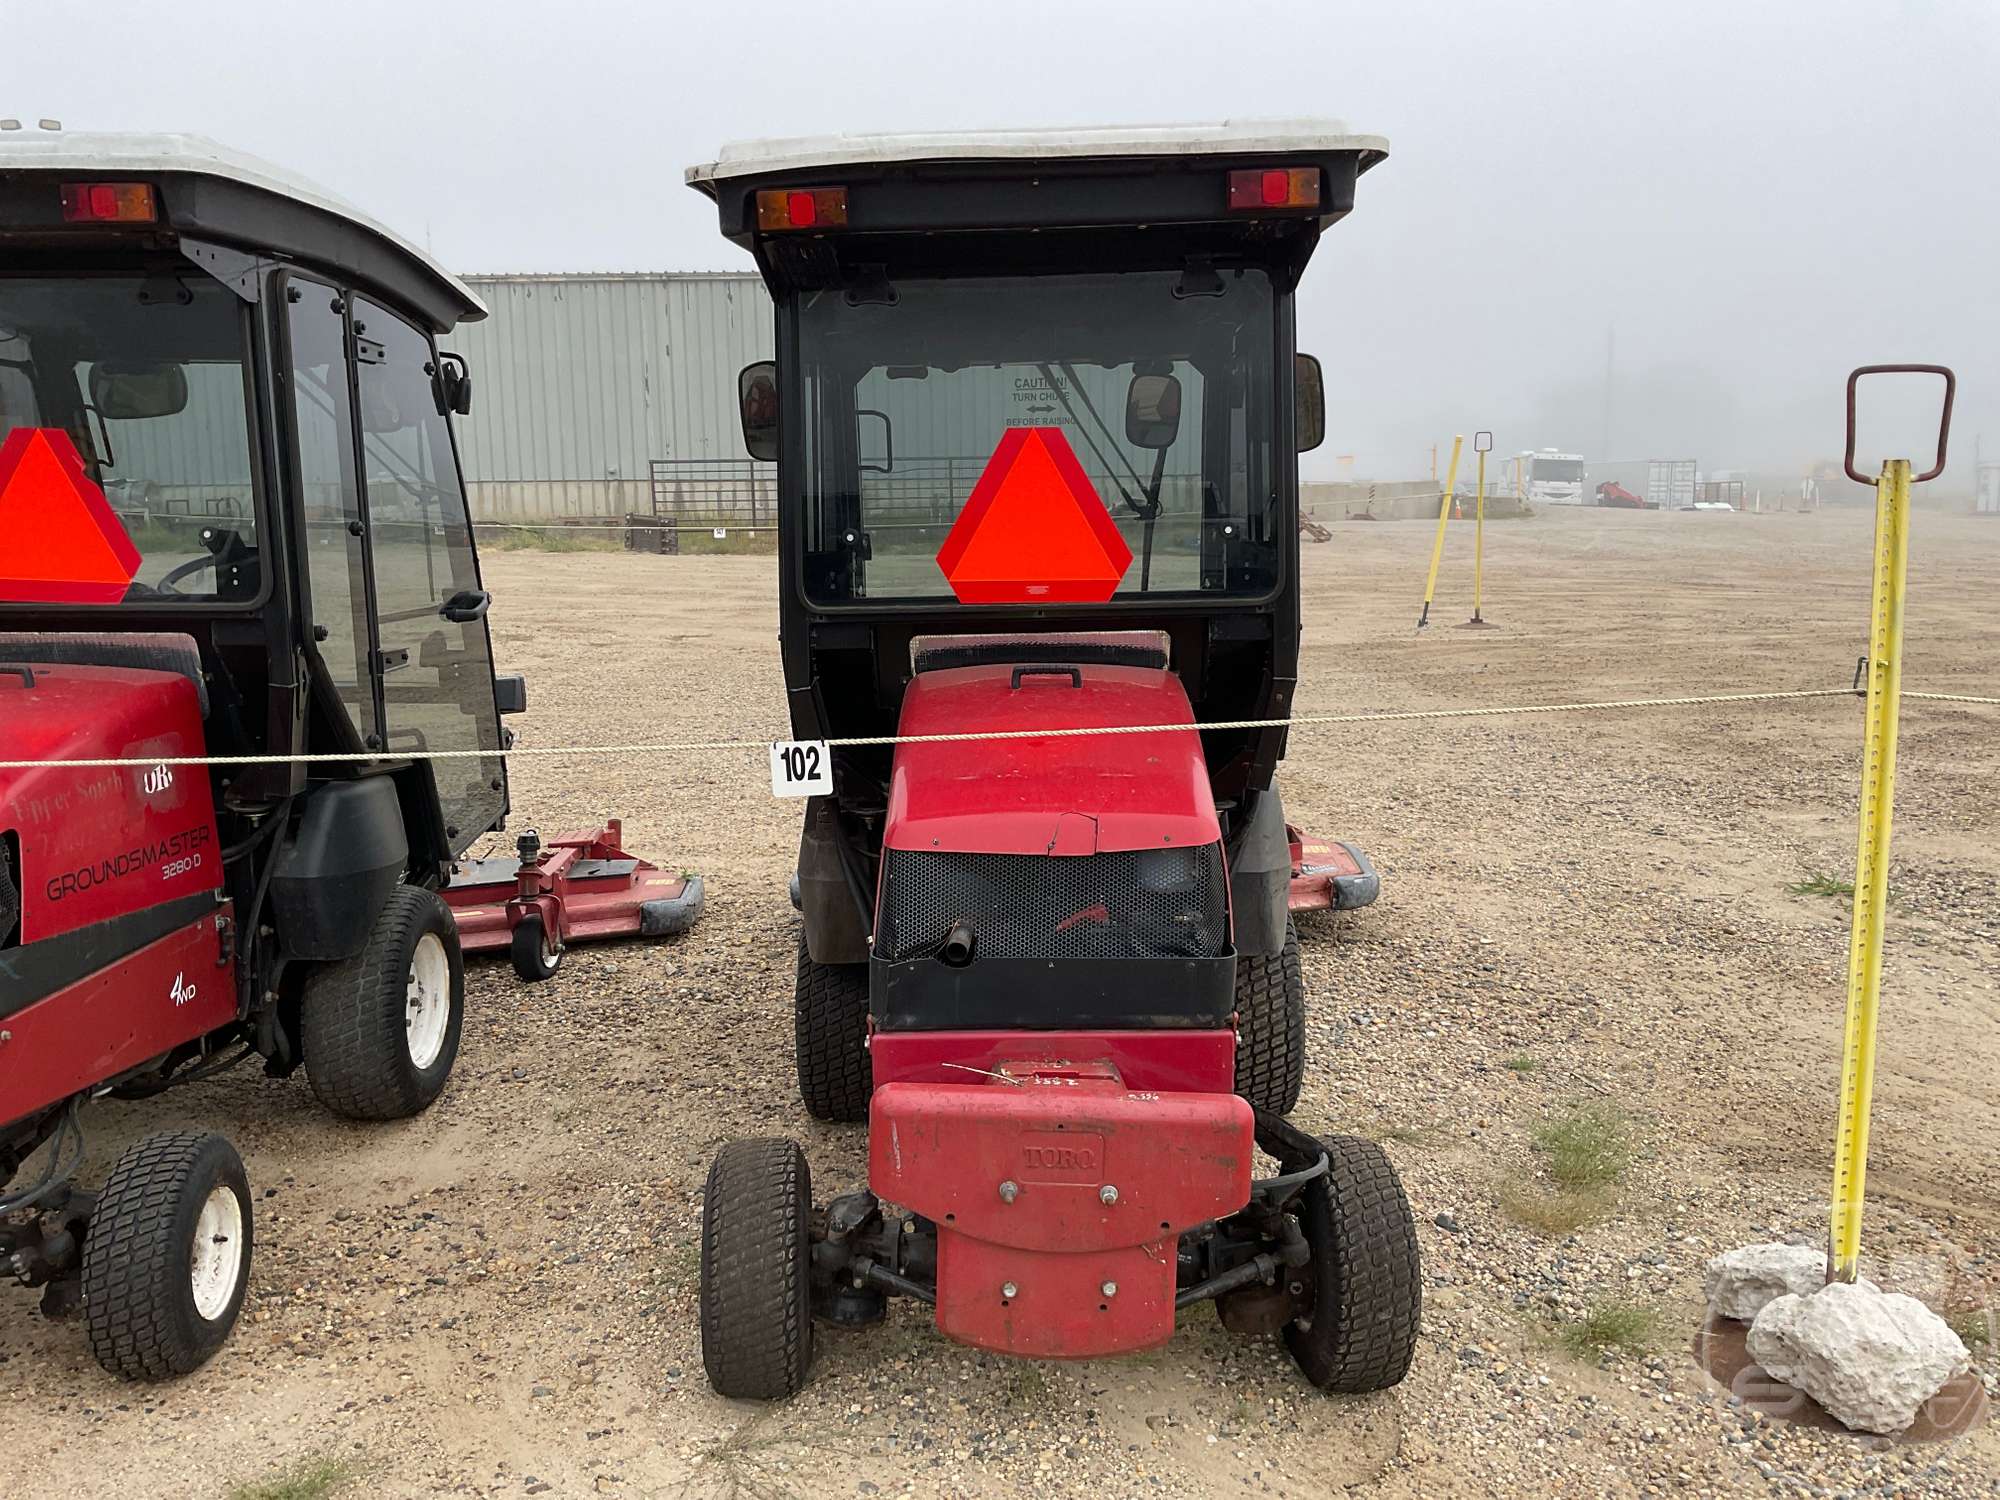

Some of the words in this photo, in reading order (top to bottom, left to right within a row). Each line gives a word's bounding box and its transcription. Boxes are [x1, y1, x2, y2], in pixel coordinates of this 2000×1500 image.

[1014, 377, 1067, 388] CAUTIN!
[1012, 392, 1037, 402] TURN
[1006, 418, 1040, 426] BEFORE
[780, 745, 822, 782] 102
[46, 825, 210, 901] GROUNDSMASTER
[170, 971, 196, 1007] 4WD
[1024, 1146, 1097, 1170] TORO
